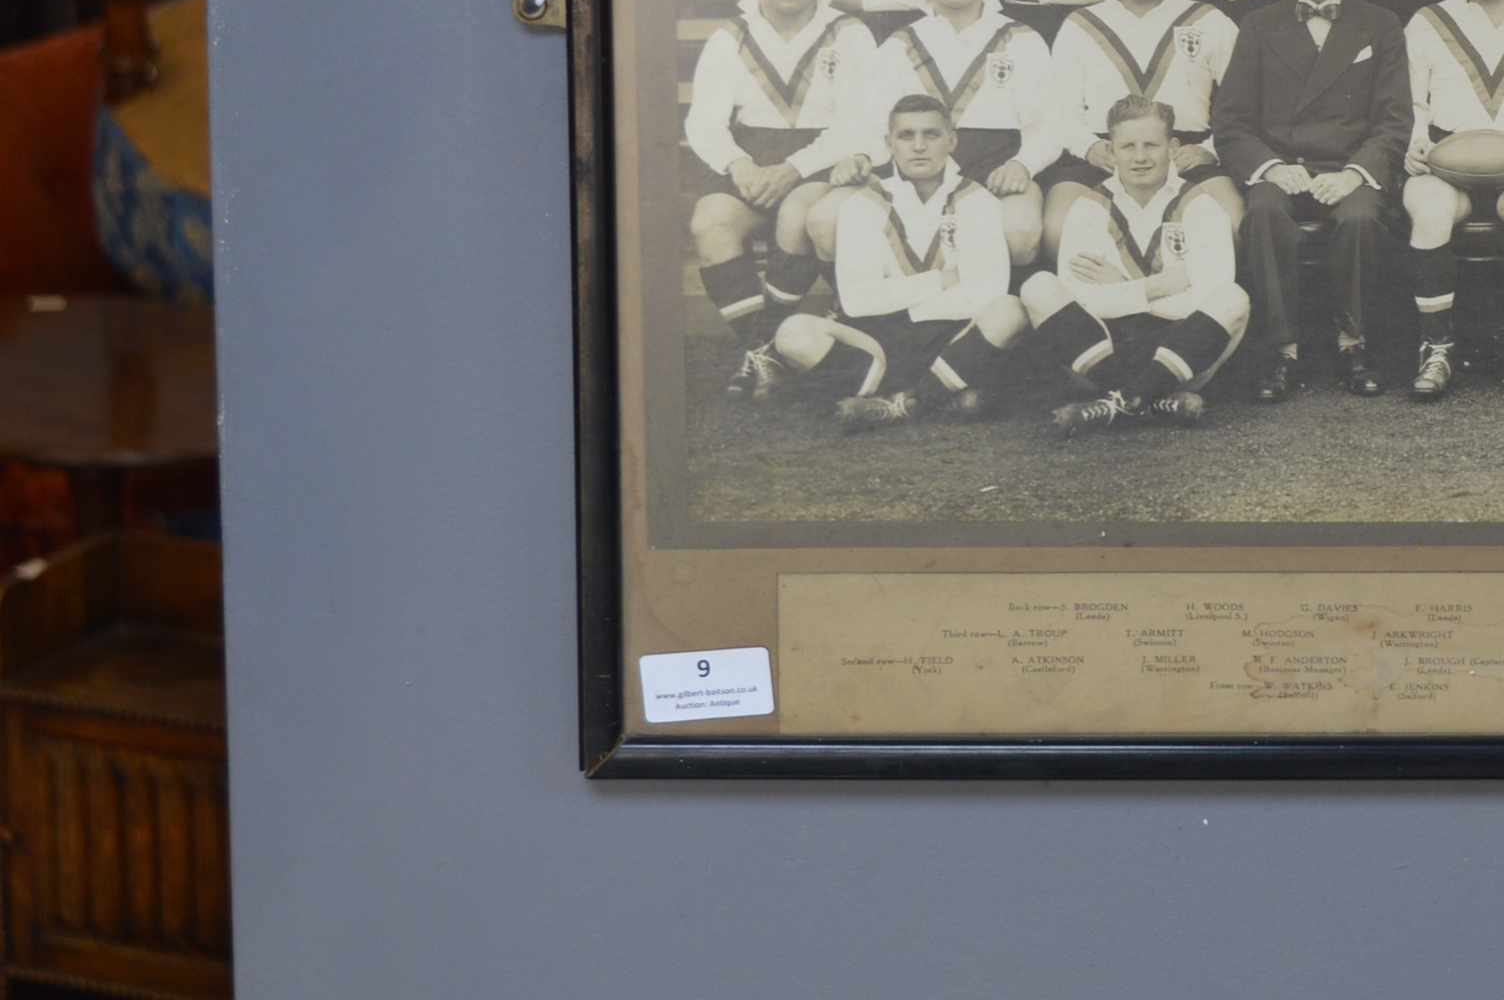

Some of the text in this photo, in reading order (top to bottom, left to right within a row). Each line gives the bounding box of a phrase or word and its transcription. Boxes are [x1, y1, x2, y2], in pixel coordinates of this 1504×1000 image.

[1009, 603, 1030, 611] Back
[1075, 603, 1128, 611] BROGDEN
[1186, 603, 1198, 611] H.
[1204, 603, 1244, 611] WOODS
[1301, 604, 1312, 612] G.
[1318, 604, 1358, 612] DAVIES
[1416, 604, 1424, 612] F.
[1431, 604, 1472, 612] HARRIS
[1075, 613, 1110, 621] (Leeds)
[1186, 613, 1231, 621] (Liverpool
[1313, 614, 1349, 622] (Wigan)
[1428, 614, 1461, 622] (Leeds)
[942, 630, 967, 638] Third
[1030, 629, 1068, 637] TROUP
[1141, 629, 1184, 637] ARMITT
[1261, 630, 1314, 638] HODGSON
[1008, 639, 1048, 647] (Barrow)
[1134, 639, 1177, 647] (Swinton)
[1252, 639, 1295, 647] (Swinton)
[1380, 640, 1439, 649] (Warrington)
[841, 657, 873, 665] Second
[1012, 656, 1023, 664] A.
[1419, 657, 1465, 665] BROUGH
[697, 659, 711, 678] 9
[912, 666, 942, 674] (York)
[1021, 665, 1075, 674] (Castleford)
[1141, 665, 1200, 673] (Warrington)
[1259, 666, 1301, 674] (Business
[1304, 666, 1347, 674] Manager)
[1417, 667, 1451, 675] (Leeds)
[655, 685, 758, 699] www.gilbert-baitson.co.uk
[1405, 683, 1449, 692] JENKINS
[1279, 691, 1318, 700] (Salford)
[1397, 692, 1436, 700] (Salford)
[675, 699, 740, 710] Auction: Antique
